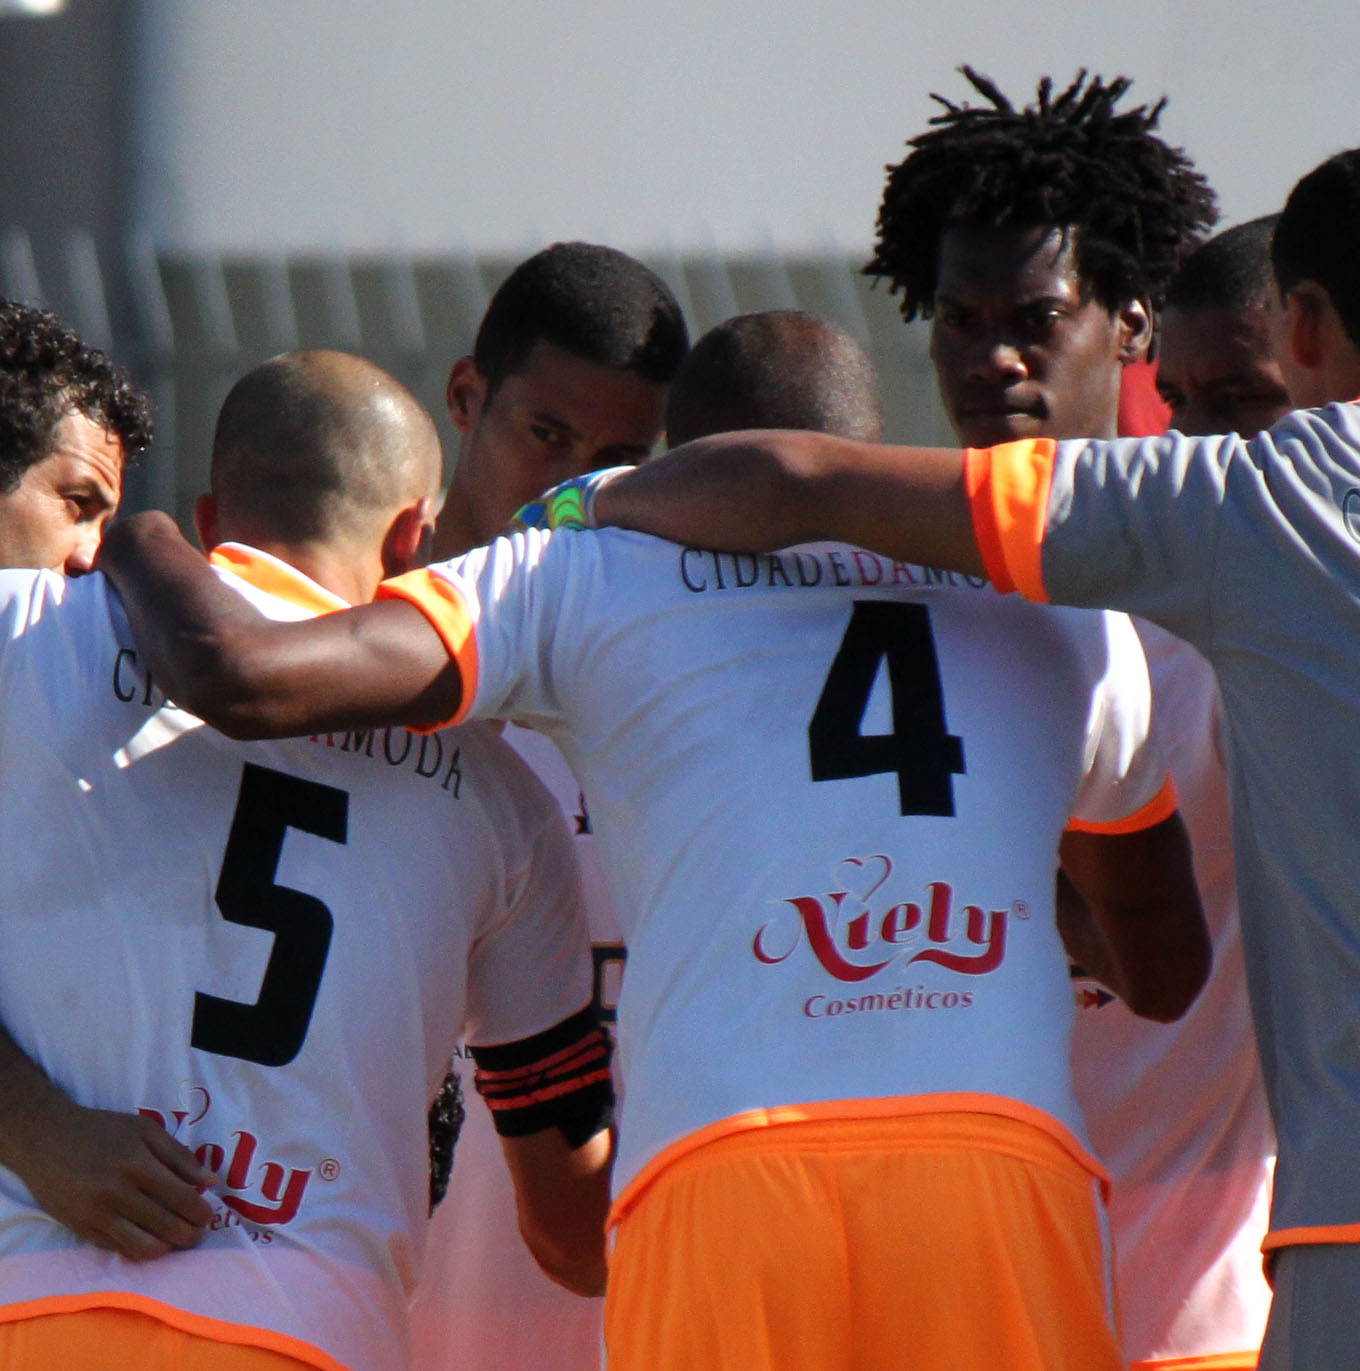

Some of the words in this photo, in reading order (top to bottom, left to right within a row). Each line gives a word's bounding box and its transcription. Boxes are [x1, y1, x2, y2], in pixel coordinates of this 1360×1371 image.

[807, 600, 967, 817] 4
[191, 762, 349, 1067] 5
[753, 881, 1009, 982] Niely
[803, 985, 974, 1018] Cosméticos
